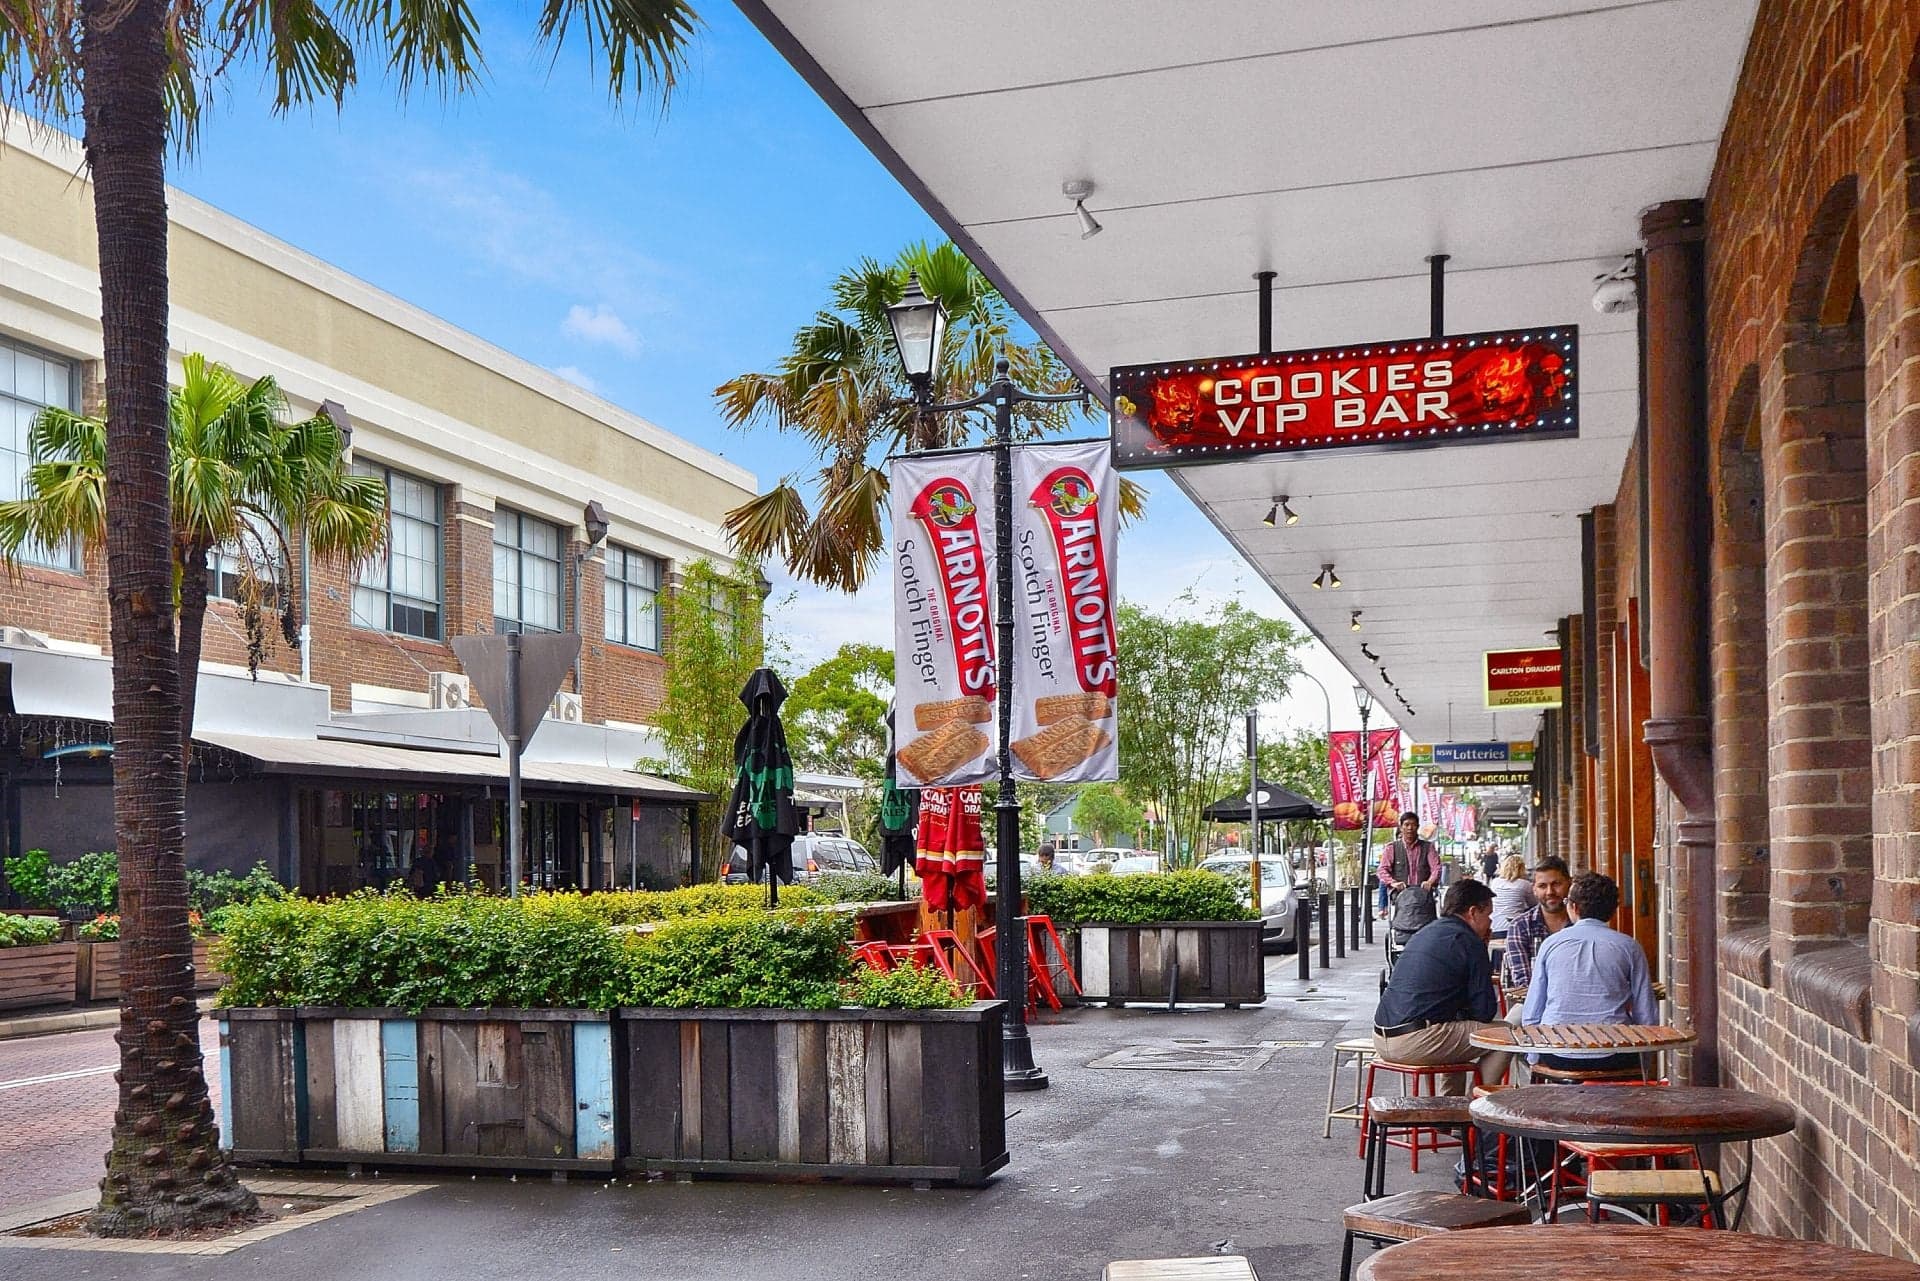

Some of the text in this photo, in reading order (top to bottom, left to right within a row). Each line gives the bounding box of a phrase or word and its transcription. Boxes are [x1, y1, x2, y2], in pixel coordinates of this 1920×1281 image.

[1214, 360, 1453, 406] COOKIES
[1216, 391, 1451, 437] VIP BAR
[896, 539, 938, 687] Scotch Finger
[926, 587, 944, 643] THE ORIGINAL
[1018, 529, 1055, 679] Scotch Finger
[1045, 579, 1061, 634] THE ORIGINAL
[1060, 519, 1116, 687] ARNOTT'S
[1490, 664, 1561, 676] CARLTON DRAUGHT
[1507, 689, 1545, 697] COOKIES
[1499, 697, 1534, 705] LOUNGE
[1436, 749, 1453, 757] NSW
[1453, 749, 1505, 760] Lotteries
[883, 806, 906, 816] ALES
